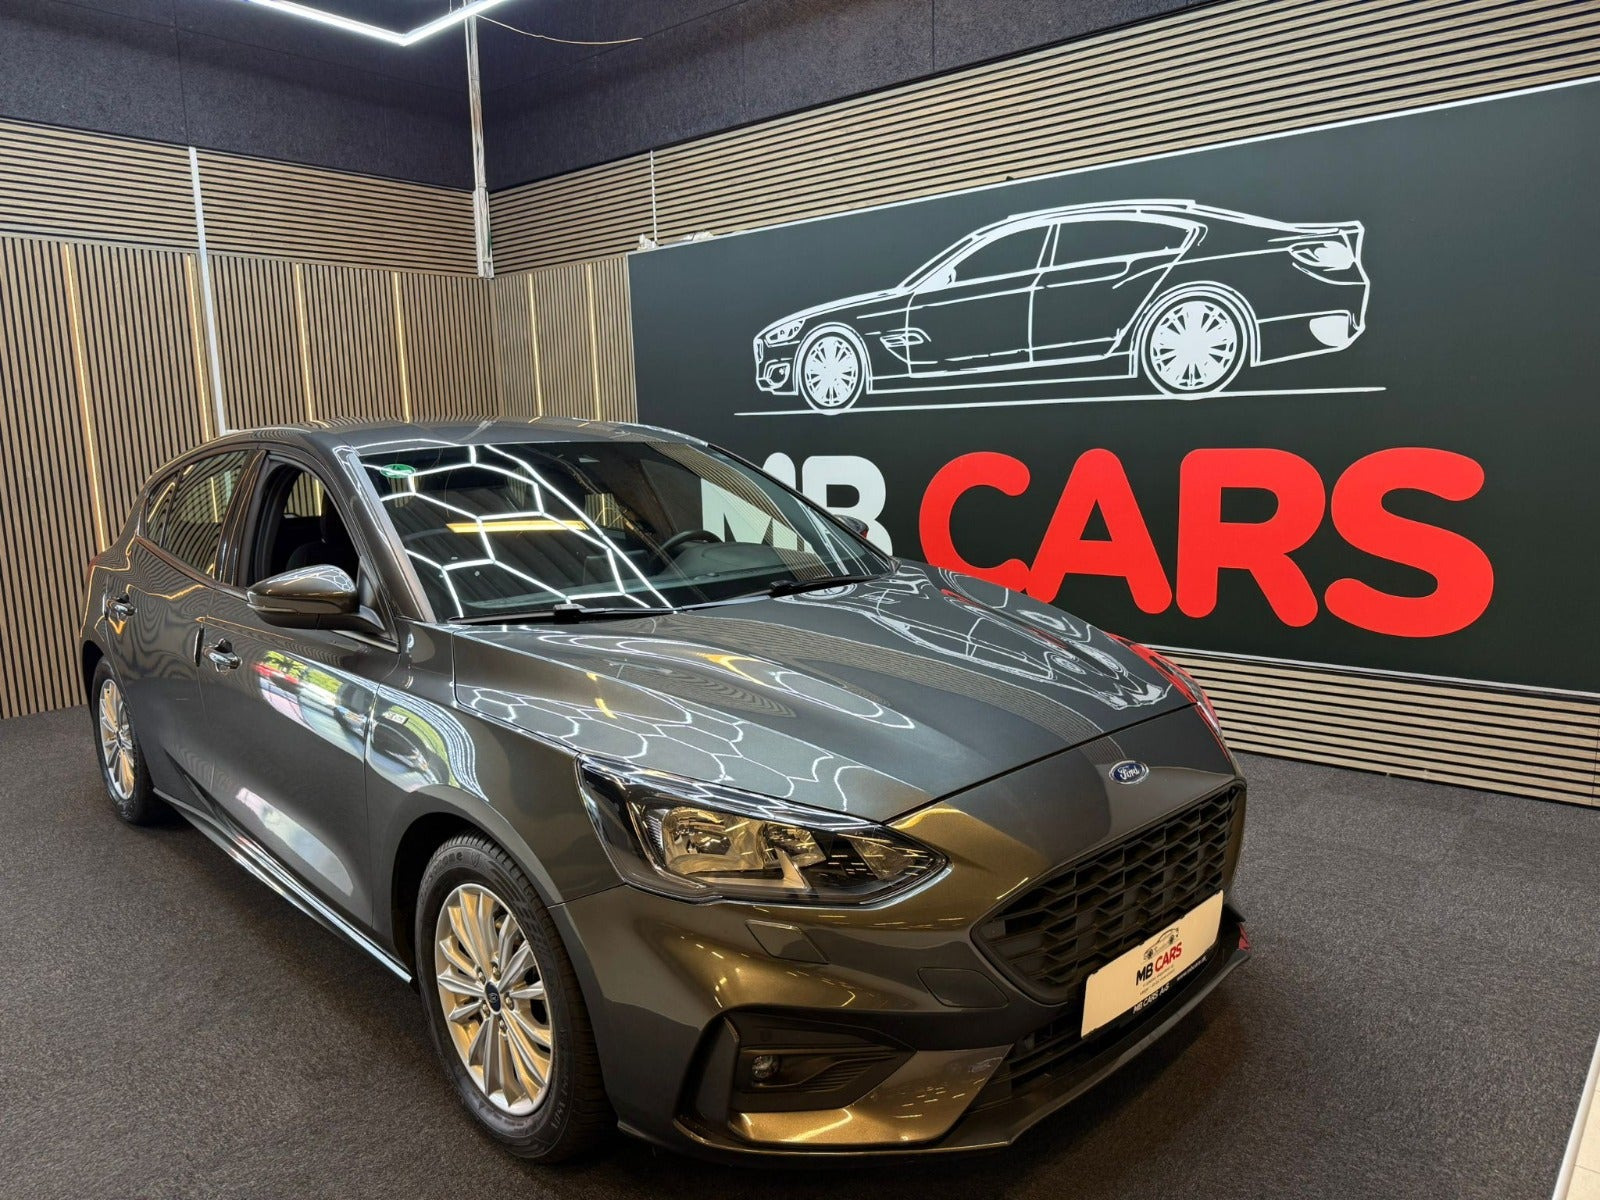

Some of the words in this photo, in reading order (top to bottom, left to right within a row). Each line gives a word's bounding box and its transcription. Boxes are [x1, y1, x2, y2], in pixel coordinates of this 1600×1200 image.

[919, 447, 1494, 637] CARS
[1117, 765, 1141, 780] Ford
[1135, 962, 1154, 986] MB
[1155, 941, 1182, 972] CARS
